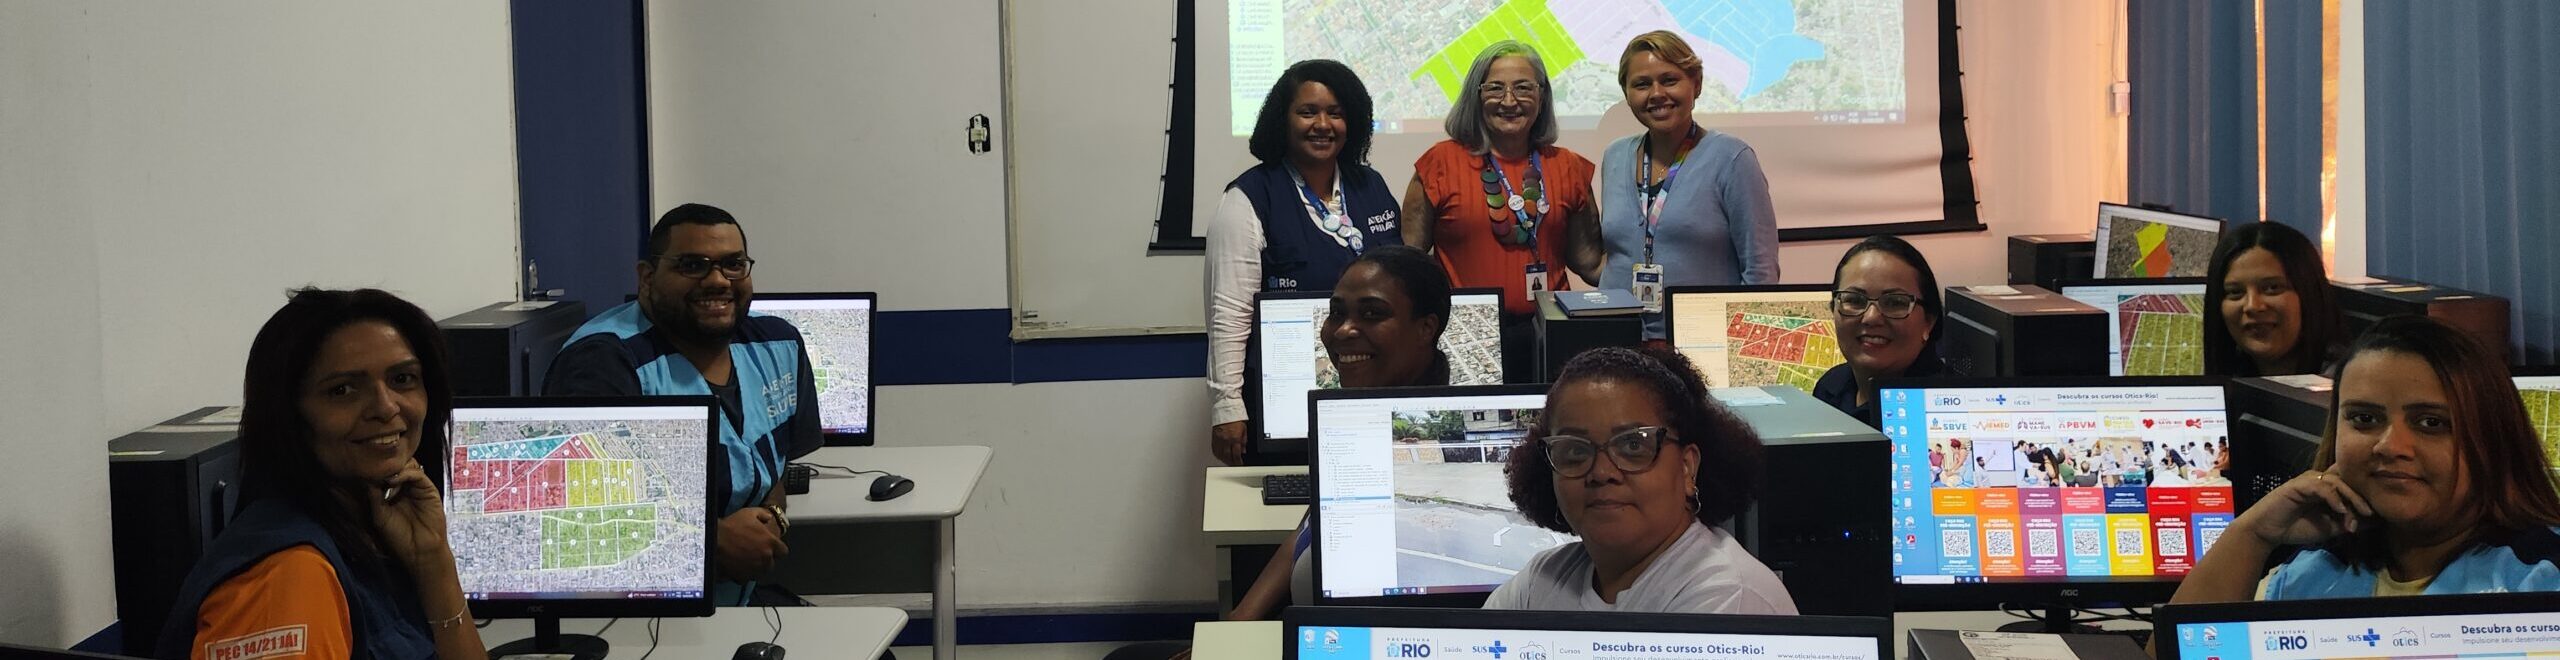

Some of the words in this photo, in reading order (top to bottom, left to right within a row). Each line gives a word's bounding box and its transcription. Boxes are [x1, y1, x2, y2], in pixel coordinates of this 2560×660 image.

[1279, 278, 1297, 288] Rio
[1943, 397, 1961, 406] RIO
[1943, 423, 1967, 431] SBVE
[2066, 421, 2096, 429] PBVM
[2461, 623, 2512, 634] Descubra
[2515, 625, 2528, 633] os
[2530, 624, 2560, 632] curso
[2279, 635, 2308, 650] RIO
[2346, 634, 2362, 643] SUS
[215, 645, 241, 660] PEC
[242, 635, 277, 656] 14/21
[1401, 643, 1431, 658] RIO
[1472, 645, 1488, 653] SUS
[1592, 642, 1646, 652] Descubra
[1649, 645, 1663, 653] os
[1666, 645, 1703, 654] cursos
[1706, 644, 1765, 655] Otics-Rio!
